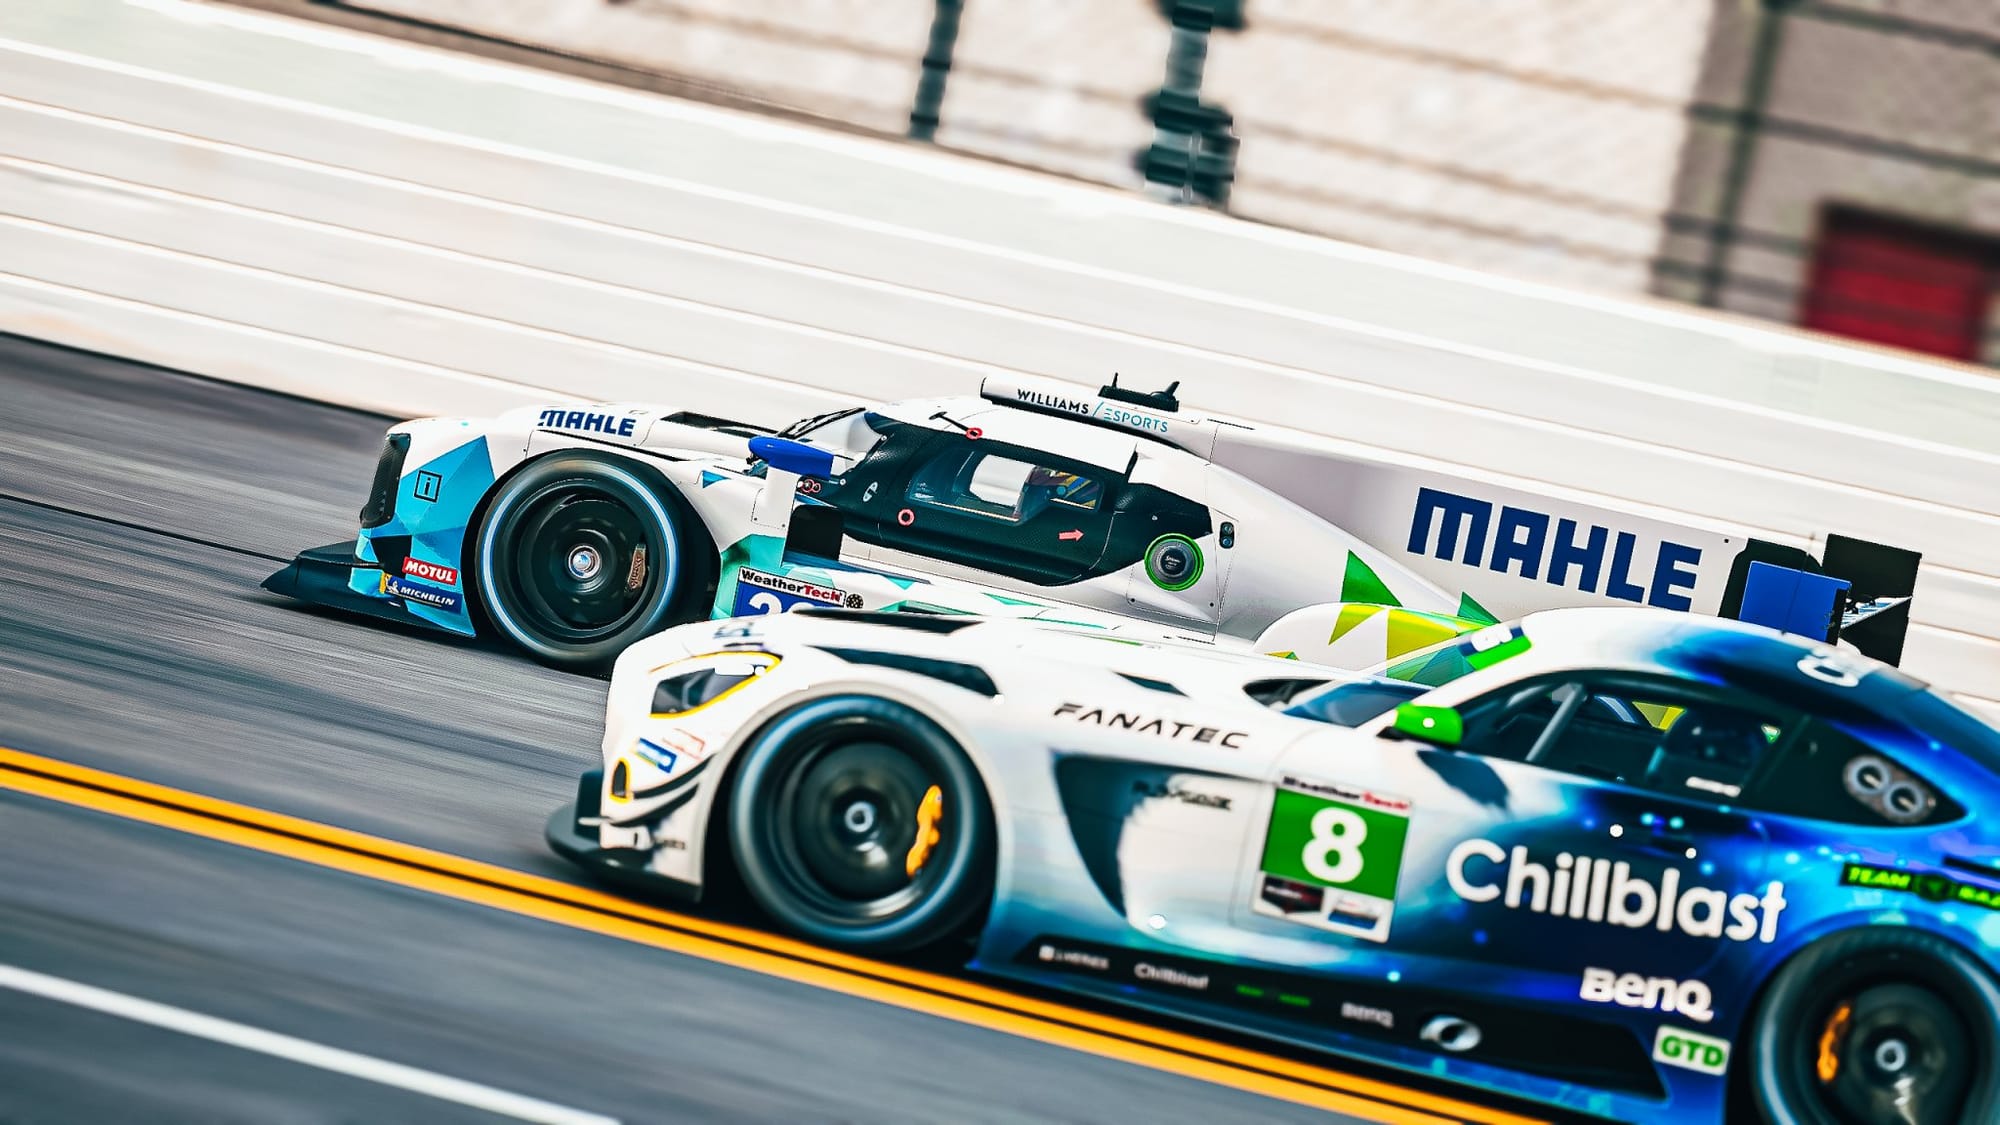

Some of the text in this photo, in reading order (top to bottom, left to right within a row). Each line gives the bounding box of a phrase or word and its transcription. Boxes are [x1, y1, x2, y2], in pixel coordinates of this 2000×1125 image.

[537, 410, 636, 437] MAHLE
[1017, 388, 1168, 433] WILLIAMS ESPORTS
[1407, 487, 1702, 613] MAHLE
[405, 560, 454, 582] MOTUL
[741, 569, 841, 603] WeatherTech
[400, 586, 455, 606] MICHELIN
[1053, 703, 1249, 749] FANATEC
[1302, 807, 1368, 884] 8
[1446, 838, 1787, 943] Chillblast
[1848, 866, 1911, 889] TEAM
[1579, 966, 1714, 1022] BenQ
[1661, 1034, 1726, 1068] GTD
